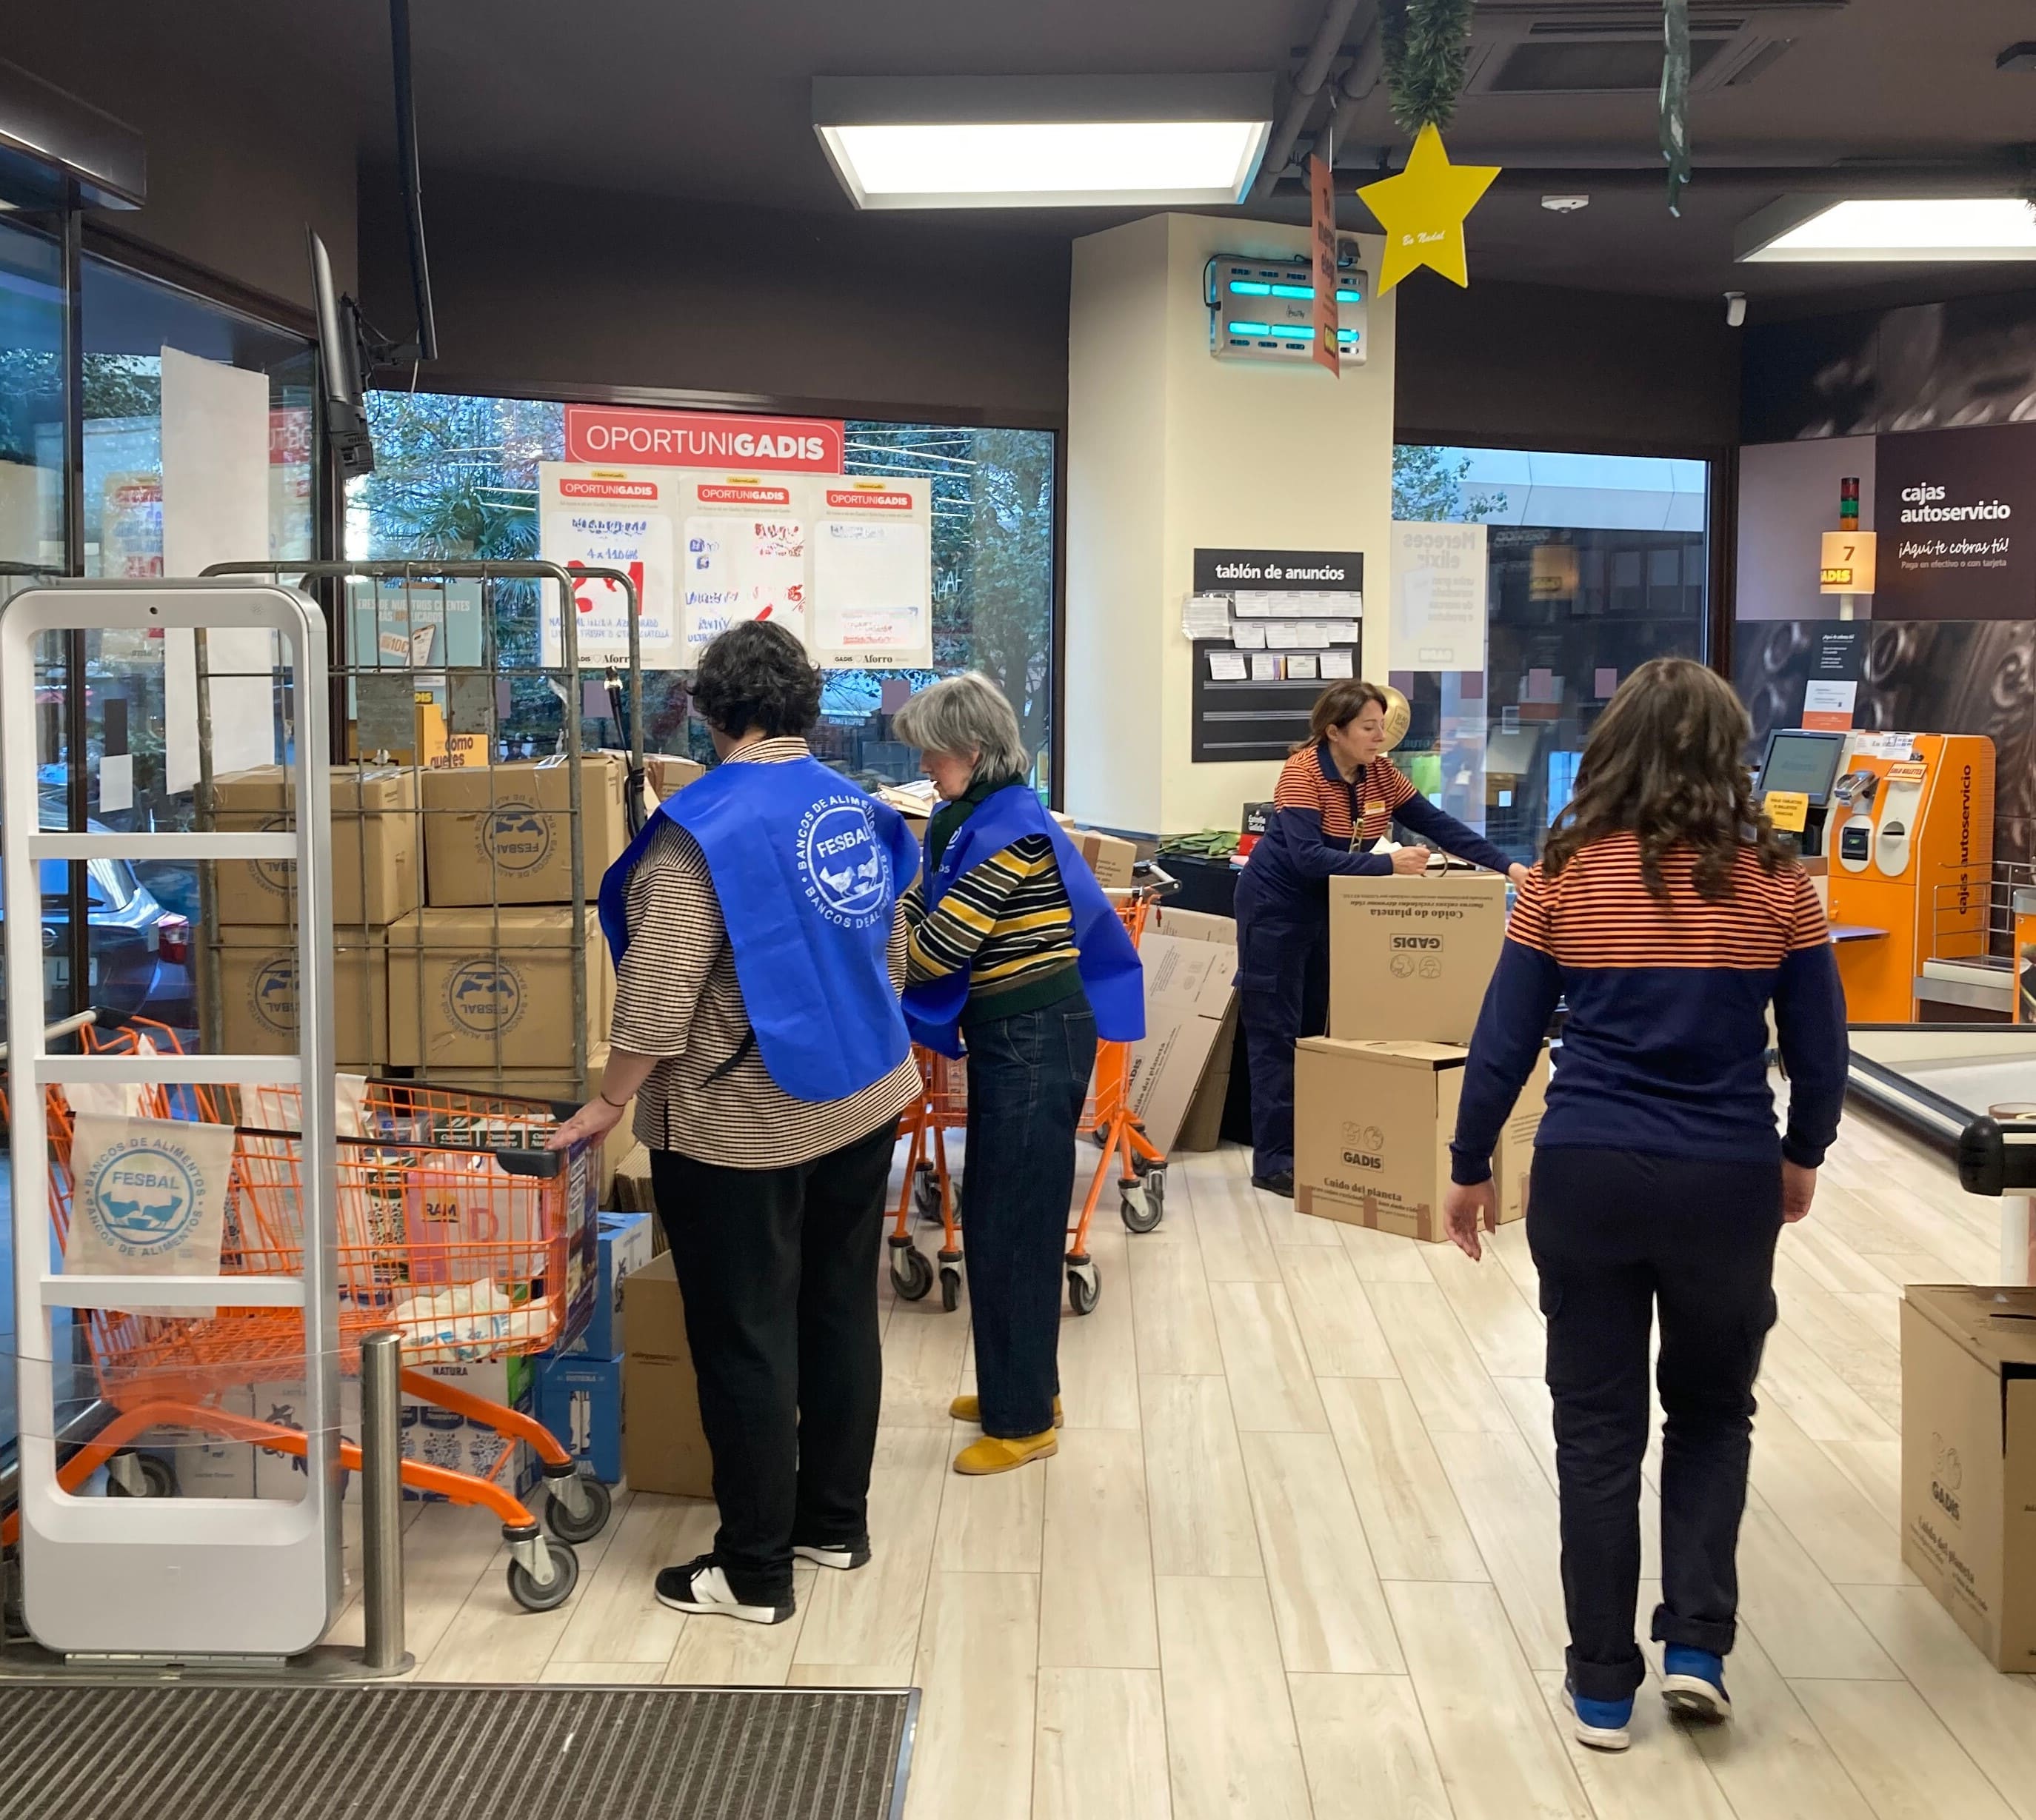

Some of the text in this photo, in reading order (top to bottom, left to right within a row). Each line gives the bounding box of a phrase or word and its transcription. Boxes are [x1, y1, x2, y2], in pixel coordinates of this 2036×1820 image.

[586, 425, 824, 461] OPORTUNIGADIS
[565, 483, 652, 495] OPORTUNIGADIS
[702, 489, 784, 501] OPORTUNIGADIS
[1901, 482, 1946, 505] cajas
[831, 494, 907, 505] OPORTUNIGADIS
[1900, 500, 2011, 523] autoservicio
[1843, 546, 1855, 561] 7
[1899, 540, 1935, 558] ¡Aquí
[1935, 540, 1948, 555] te
[1949, 538, 1990, 555] cobras
[1215, 563, 1344, 580] tablón de anuncios
[863, 655, 892, 663] Aforro
[797, 811, 814, 870] BANCOS
[812, 798, 829, 813] DE
[816, 826, 871, 858] FESBAL
[1957, 764, 1972, 914] cajas autoservicio
[804, 886, 852, 929] BANCOS
[855, 917, 869, 929] DE
[1370, 908, 1463, 920] Coido do planeta
[1393, 937, 1441, 949] GADIS
[84, 1137, 206, 1196] BANCOS DE ALIMENTOS
[1344, 1151, 1381, 1169] GADIS
[112, 1171, 180, 1190] FESBAL
[1324, 1177, 1402, 1202] Cuido del planeta
[118, 1244, 136, 1257] DE
[141, 1211, 204, 1257] ALIMENTOS
[432, 1366, 468, 1376] NATURA
